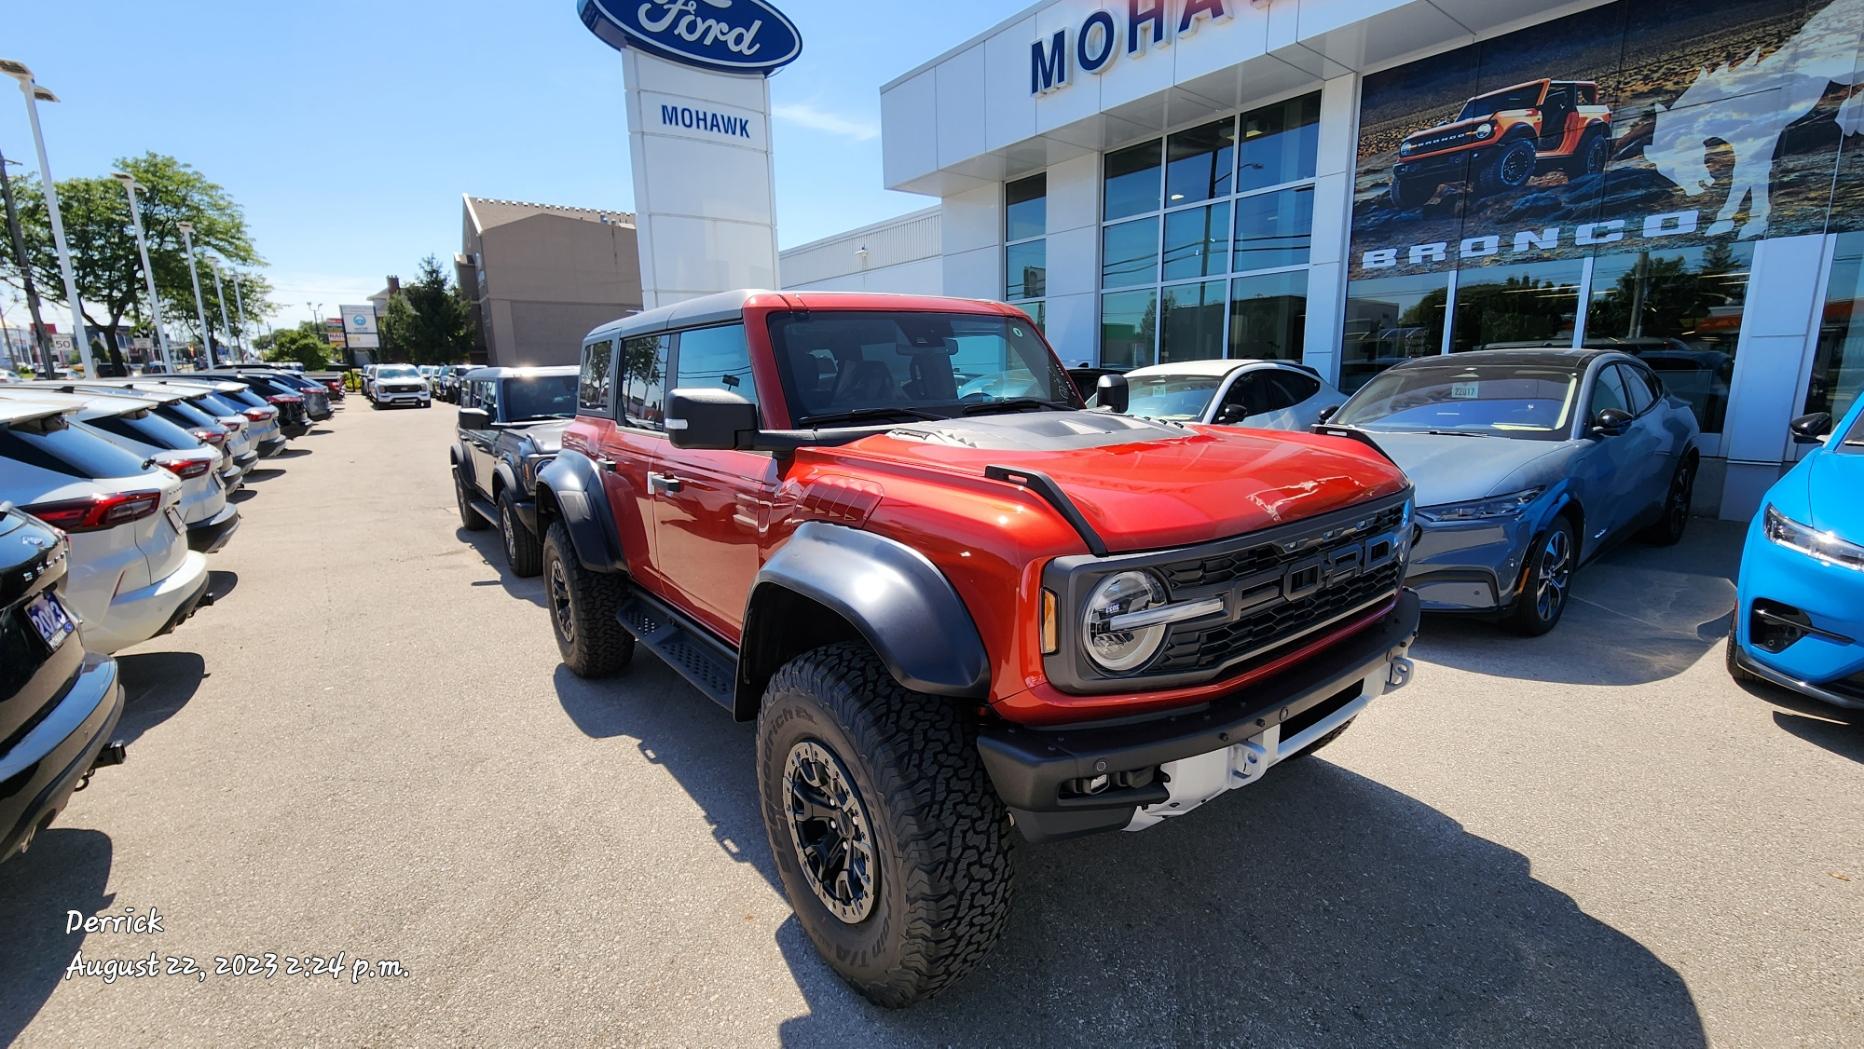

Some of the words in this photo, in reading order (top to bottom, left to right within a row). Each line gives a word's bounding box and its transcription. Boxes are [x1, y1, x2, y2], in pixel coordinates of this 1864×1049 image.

[637, 0, 761, 55] Ford
[1031, 0, 1228, 94] MOHA
[661, 105, 750, 138] MOHAWK
[1362, 210, 1699, 269] BRONCO
[55, 340, 71, 349] 50
[1232, 531, 1398, 622] FORD
[33, 601, 66, 640] 2023
